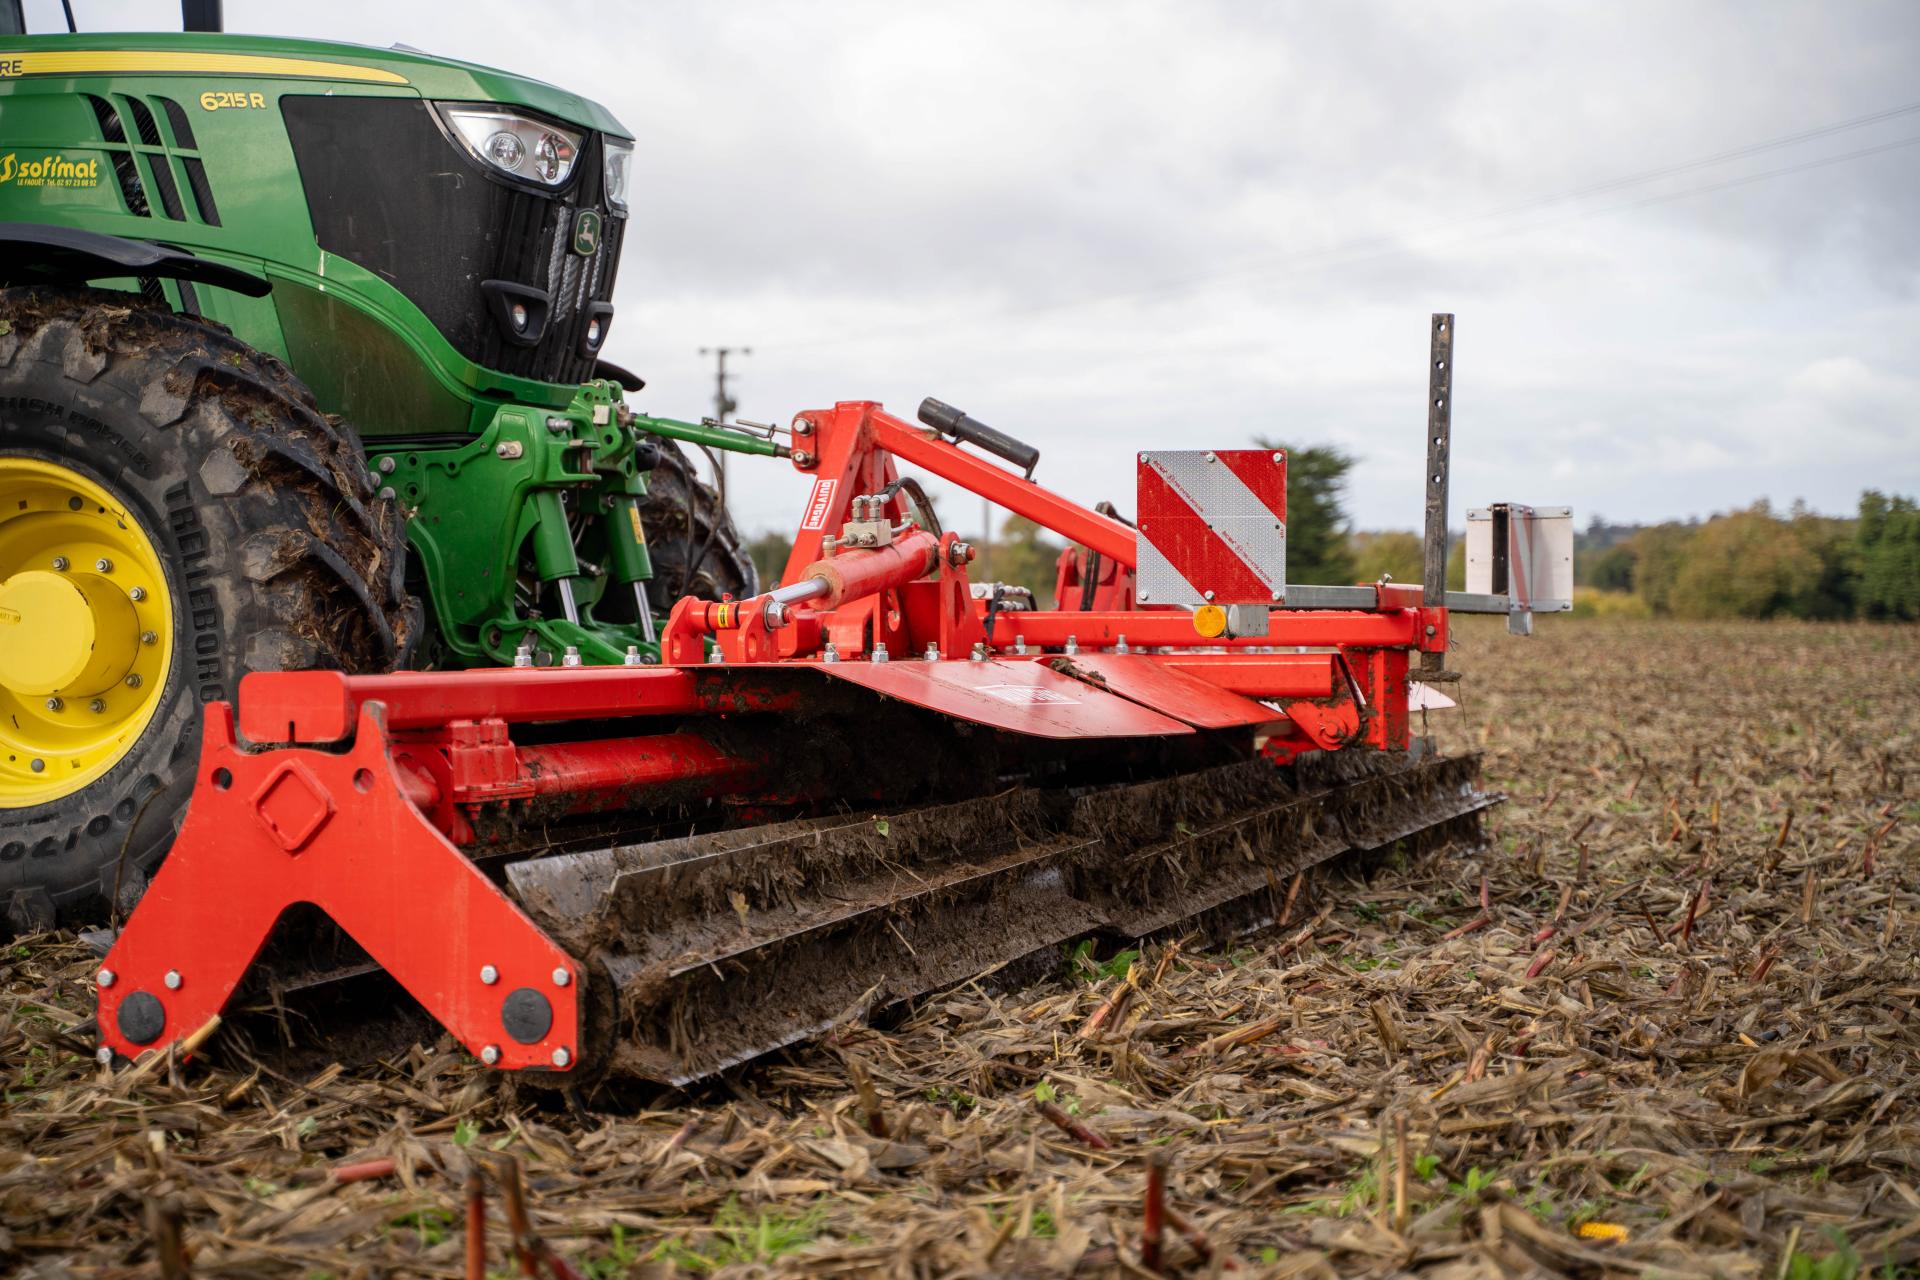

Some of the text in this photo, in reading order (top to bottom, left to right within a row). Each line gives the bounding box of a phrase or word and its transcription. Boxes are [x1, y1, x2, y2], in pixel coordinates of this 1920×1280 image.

[200, 91, 267, 111] 6215 R
[18, 155, 97, 178] sofimat
[165, 479, 225, 703] TRELLEBORG
